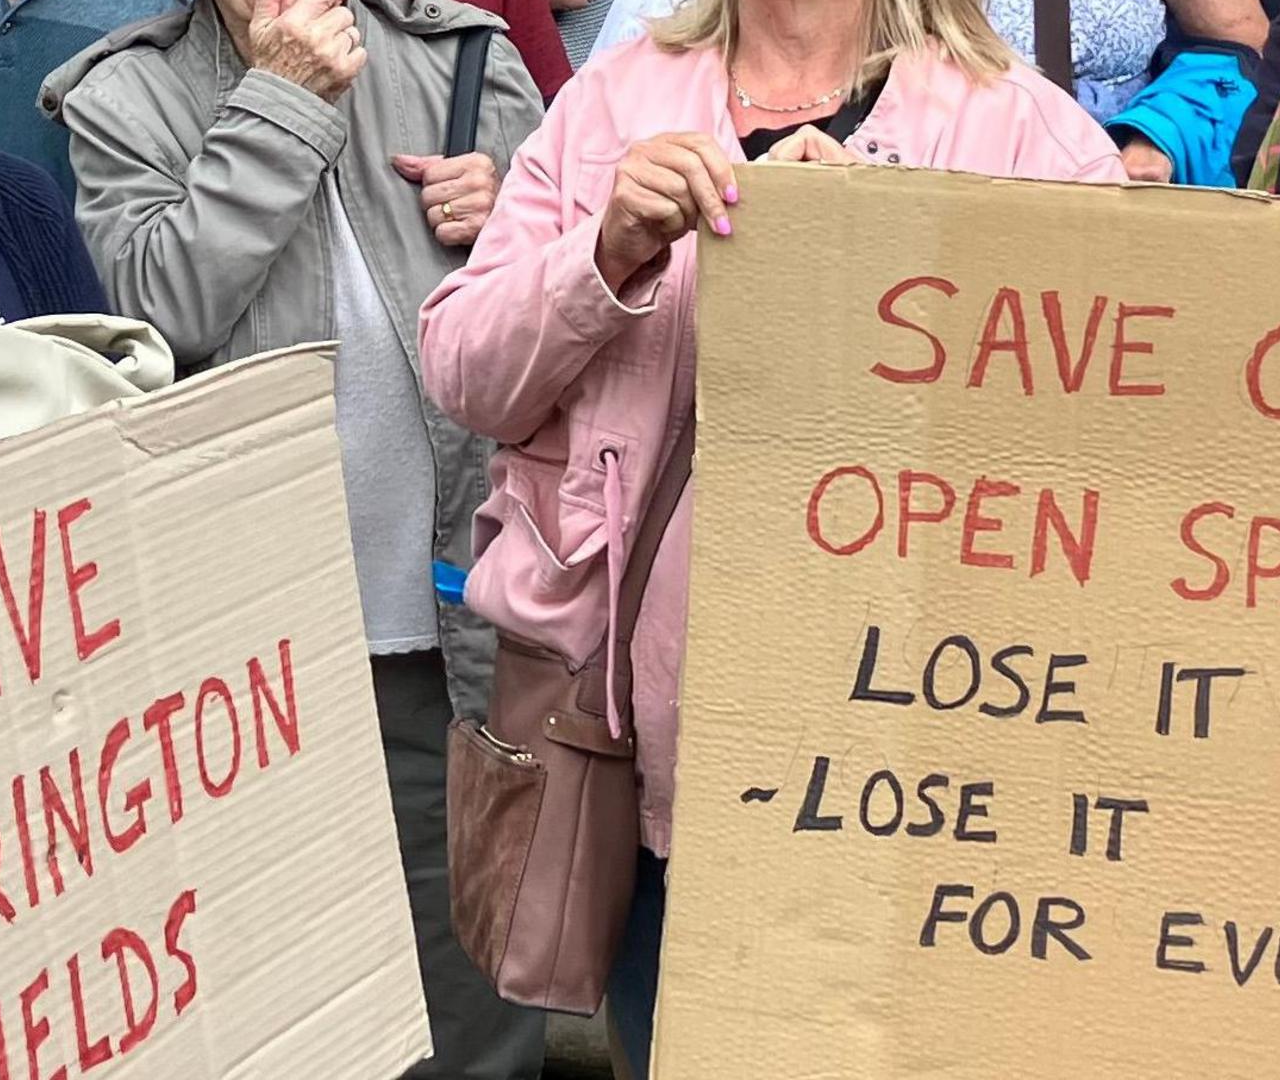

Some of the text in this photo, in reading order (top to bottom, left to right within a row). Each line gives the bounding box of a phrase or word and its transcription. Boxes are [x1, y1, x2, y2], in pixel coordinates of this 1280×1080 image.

[870, 275, 1175, 398] SAVE
[806, 464, 1100, 586] OPEN
[849, 625, 1088, 725] LOSE
[1155, 661, 1246, 738] IT
[1070, 793, 1149, 862] IT
[919, 884, 1092, 963] FOR
